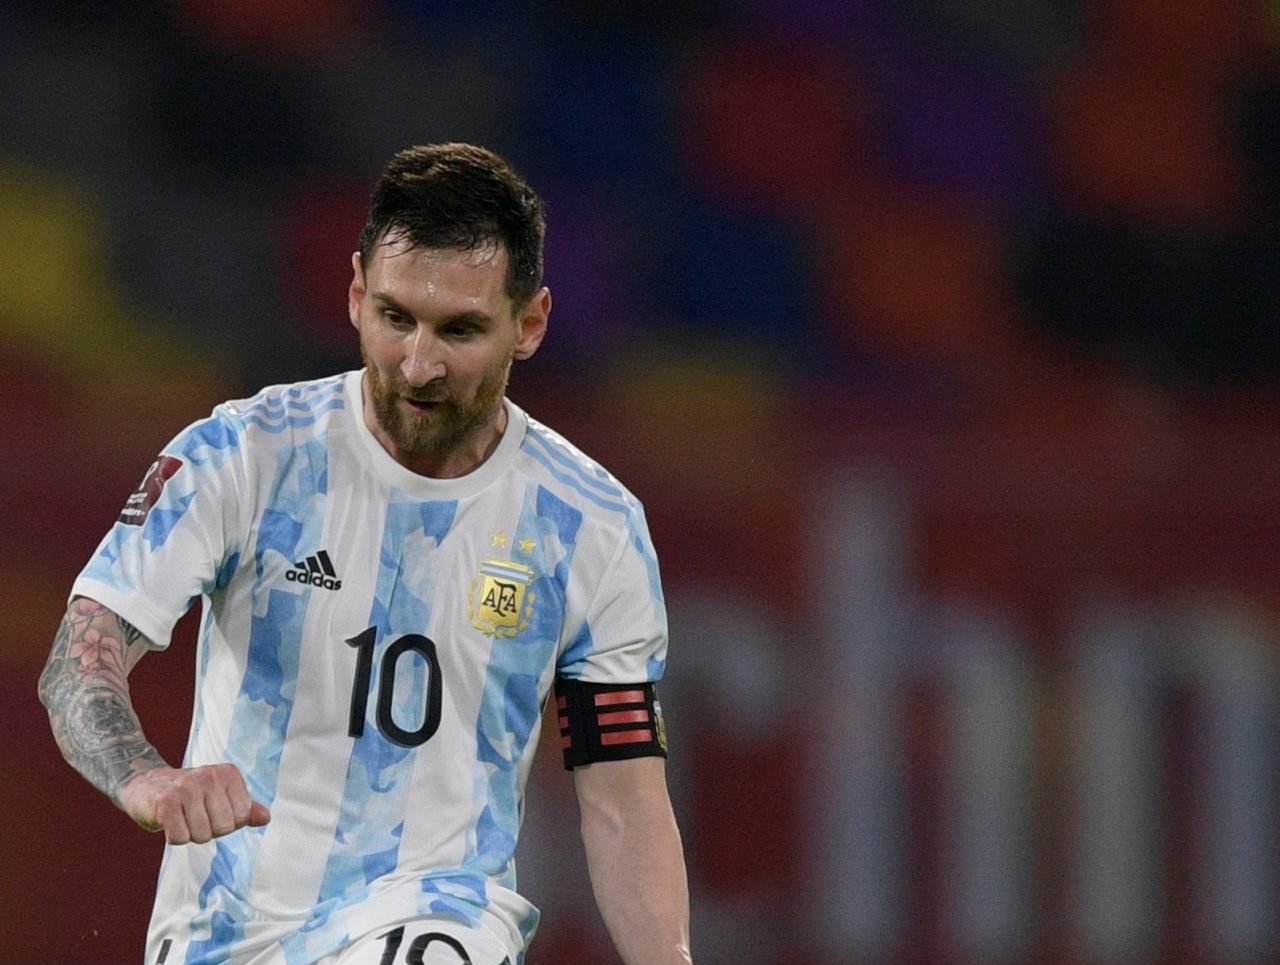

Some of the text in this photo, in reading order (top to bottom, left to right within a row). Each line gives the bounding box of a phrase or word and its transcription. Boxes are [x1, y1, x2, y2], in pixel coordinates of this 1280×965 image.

[285, 569, 342, 591] adidas
[482, 579, 517, 617] AFA
[344, 625, 442, 749] 10
